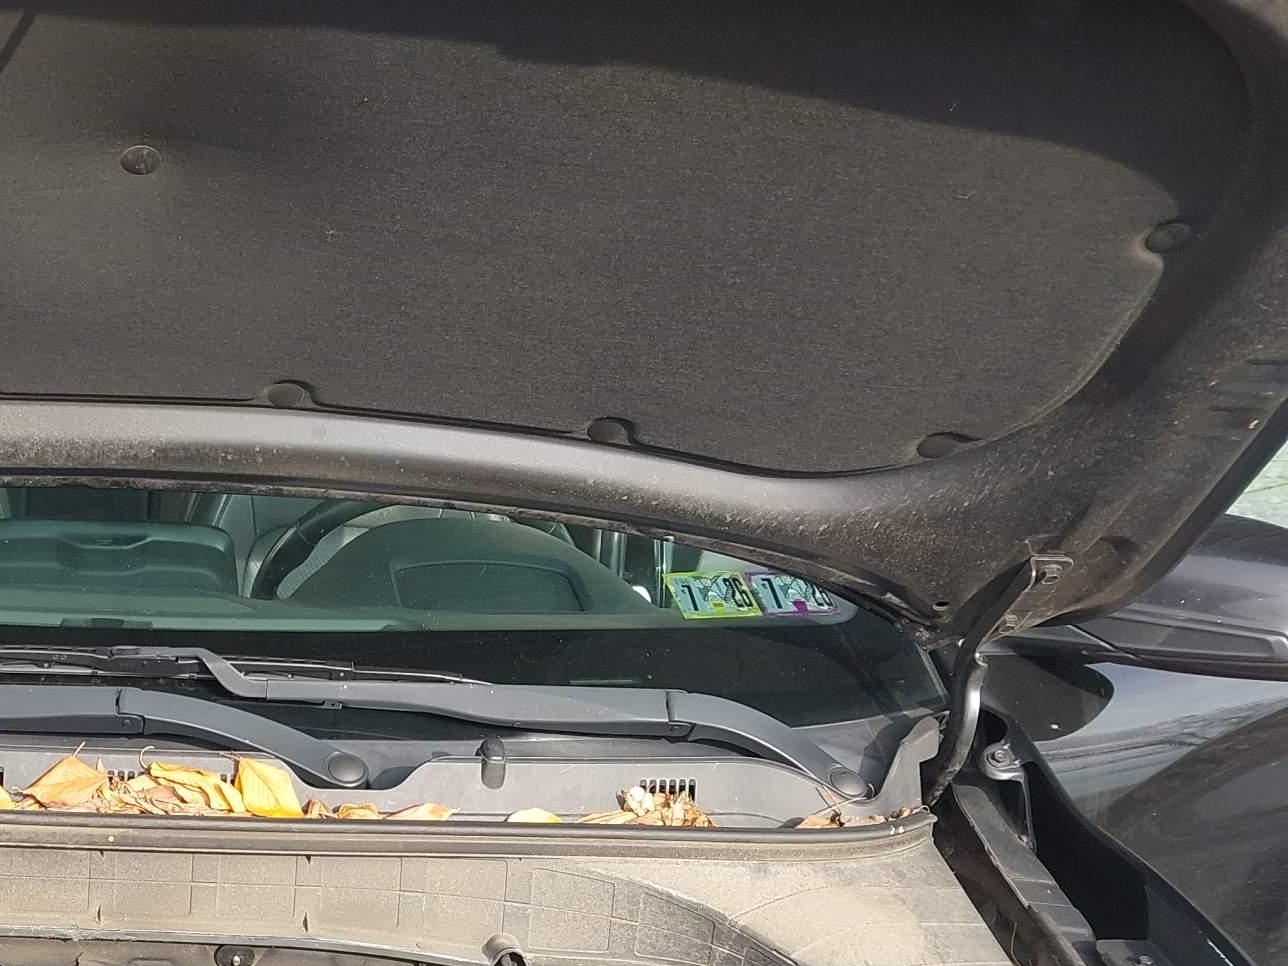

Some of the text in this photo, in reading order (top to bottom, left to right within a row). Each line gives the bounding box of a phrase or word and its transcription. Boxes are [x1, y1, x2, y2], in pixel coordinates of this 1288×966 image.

[681, 577, 754, 612] 7 26
[761, 577, 783, 609] 7
